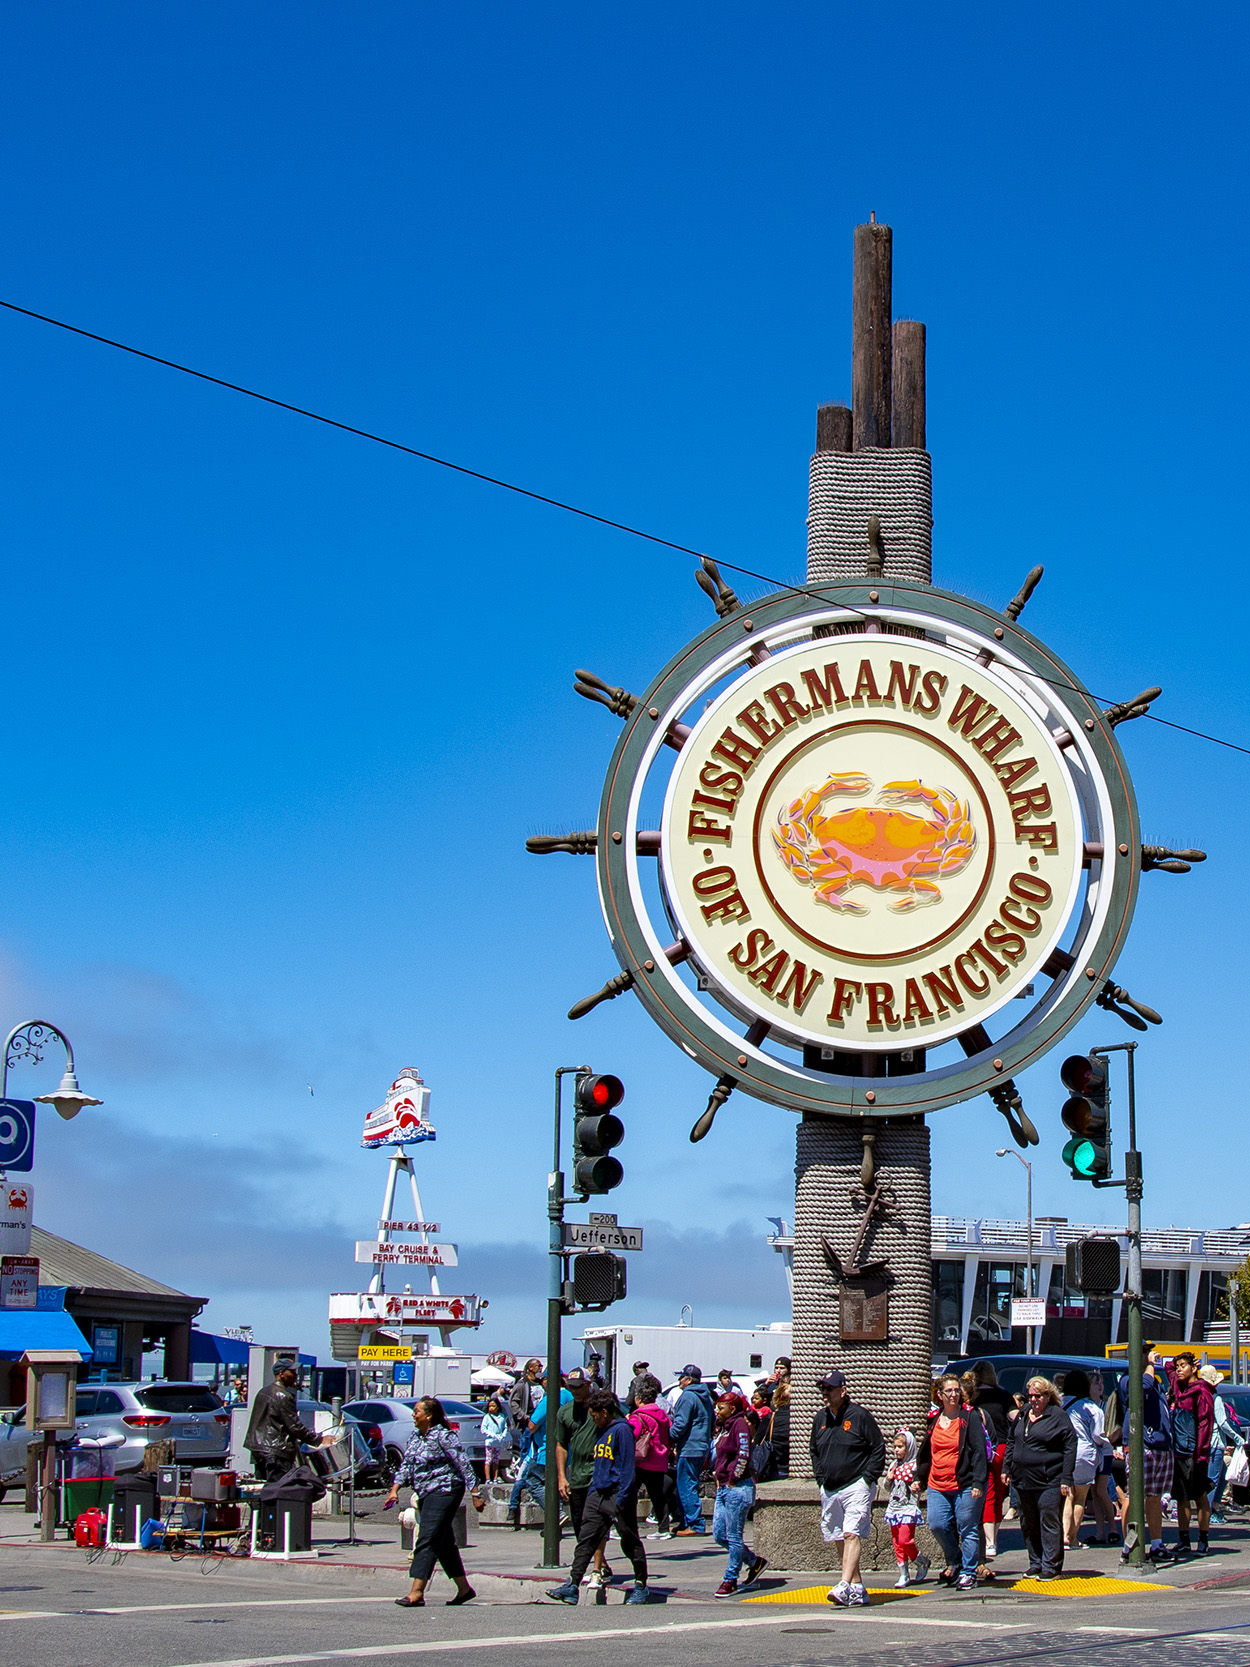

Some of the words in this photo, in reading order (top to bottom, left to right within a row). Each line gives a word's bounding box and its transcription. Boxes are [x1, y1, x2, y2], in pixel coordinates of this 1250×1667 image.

[687, 658, 948, 846] FISHERMANS
[945, 683, 1060, 857] WHARF
[690, 864, 750, 927] OF
[727, 926, 824, 1016] SAN
[826, 870, 1053, 1032] FRANCISCO
[600, 1215, 615, 1224] 200
[384, 1222, 403, 1230] PIER
[407, 1223, 418, 1231] 43
[422, 1223, 437, 1232] 1/2
[571, 1229, 636, 1245] Jefferson
[379, 1244, 394, 1252] BAY
[398, 1245, 428, 1254] CRUISE
[432, 1246, 438, 1254] &
[372, 1254, 400, 1263] FERRY
[403, 1255, 444, 1265] TERMINAL
[2, 1265, 13, 1274] NO
[738, 1432, 749, 1458] LOVE
